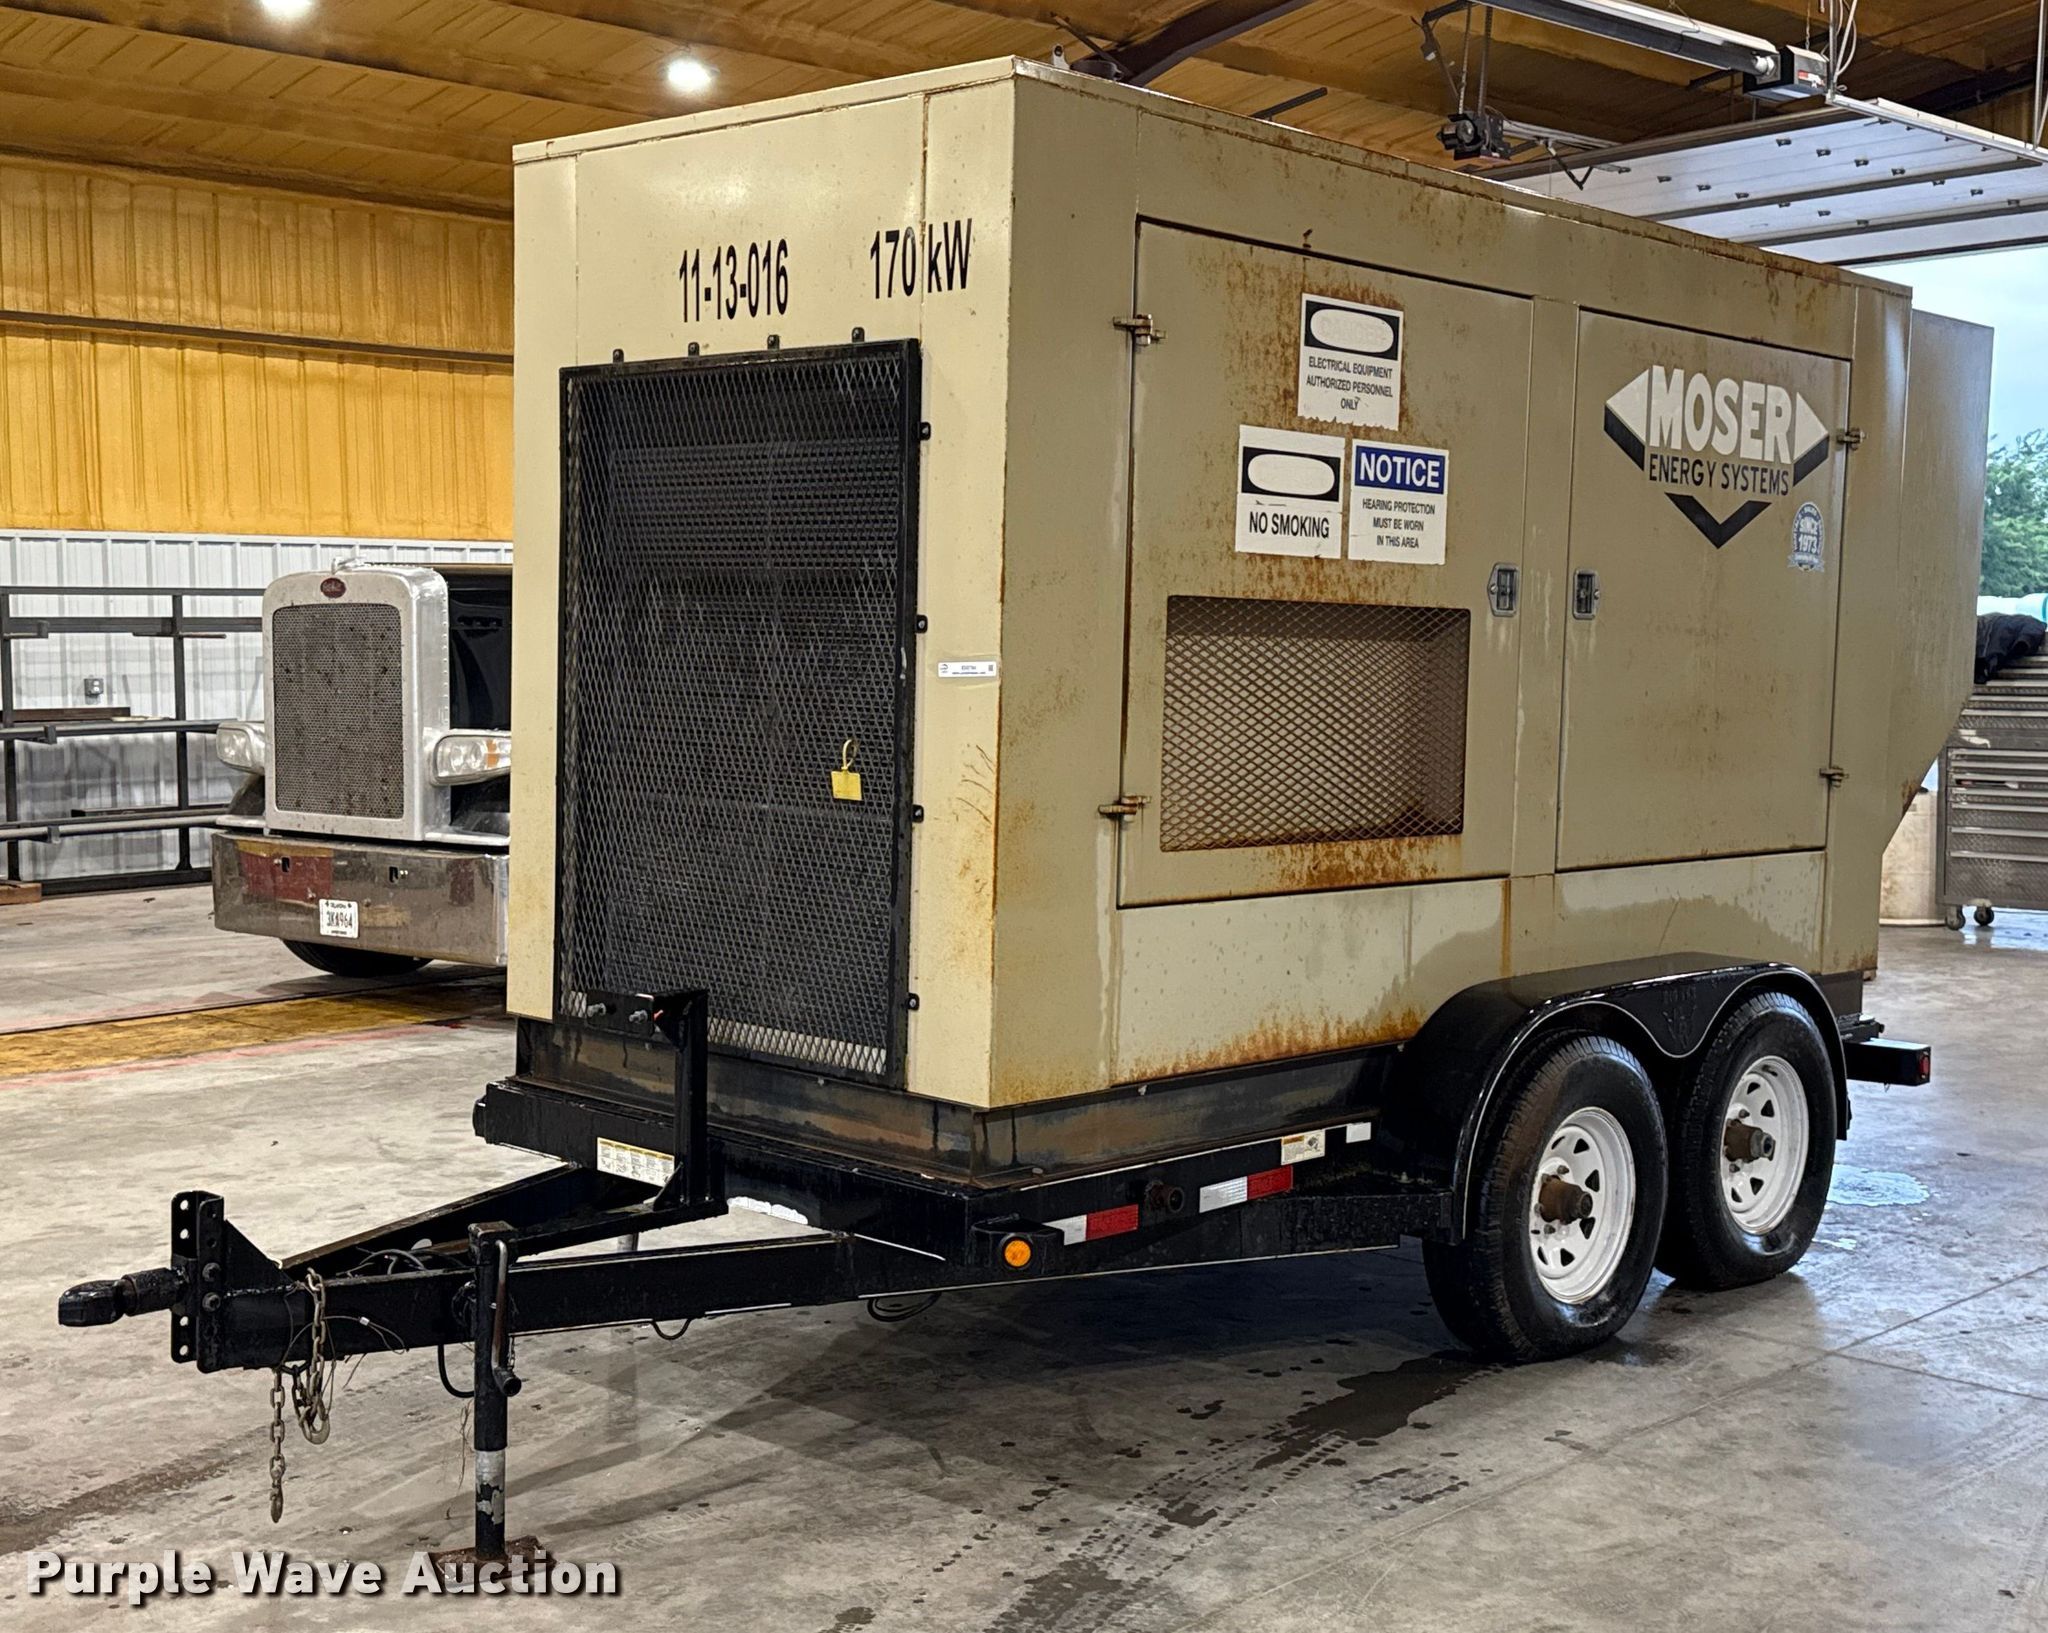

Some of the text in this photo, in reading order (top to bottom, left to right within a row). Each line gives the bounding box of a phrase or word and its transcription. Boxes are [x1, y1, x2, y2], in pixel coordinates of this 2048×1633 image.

[870, 218, 972, 299] 170 kW
[679, 238, 788, 323] 11-13-016
[1309, 356, 1393, 379] ELECTRICAL EQUIPMENT
[1306, 375, 1393, 397] AUTHORIZED PERSONNEL
[1340, 397, 1359, 410] ONLY
[1649, 364, 1792, 465] MOSER
[1360, 453, 1441, 488] NOTICE
[1649, 453, 1789, 496] ENERGY SYSTEMS
[1362, 498, 1436, 515] HEARING PROTECTION
[1249, 511, 1330, 539] NO SMOKING
[1372, 517, 1424, 532] MUST BE WORN
[1376, 535, 1419, 549] IN THIS AREA
